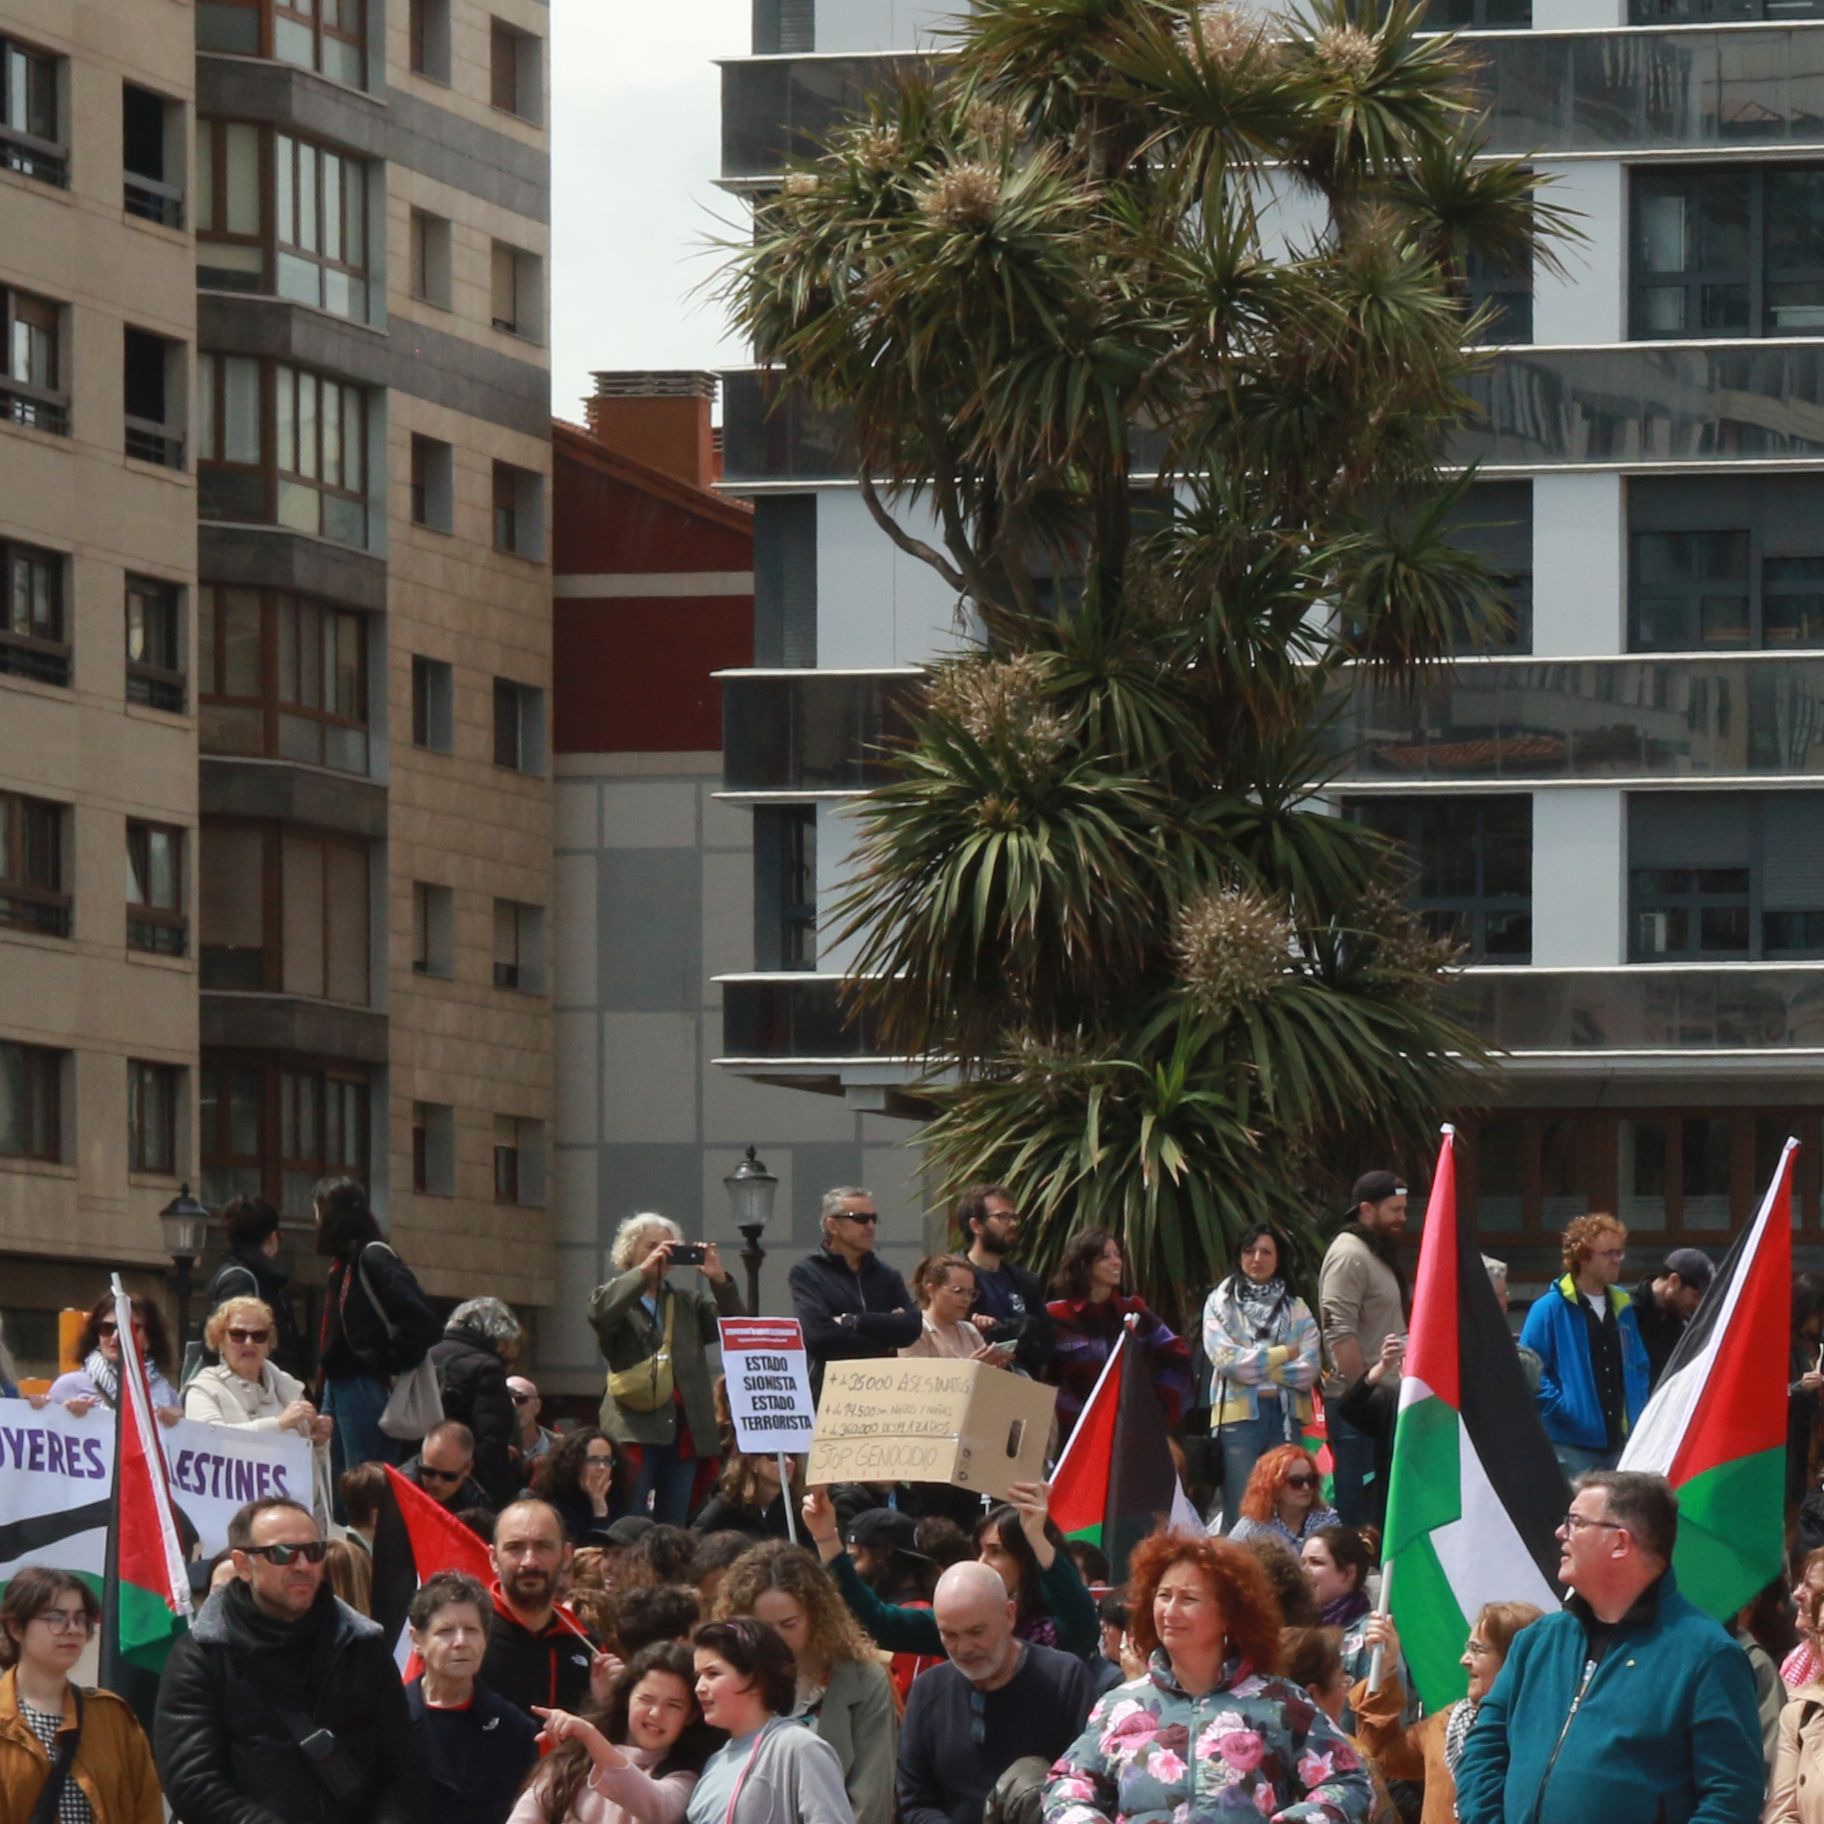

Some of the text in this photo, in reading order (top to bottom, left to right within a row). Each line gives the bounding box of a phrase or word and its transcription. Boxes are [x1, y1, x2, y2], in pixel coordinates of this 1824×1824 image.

[745, 1356, 788, 1372] ESTADO
[743, 1375, 797, 1391] SIONISTA
[751, 1396, 796, 1411] ESTADO
[740, 1414, 813, 1431] TERRORISTA
[855, 1443, 939, 1468] GENOCIDIO
